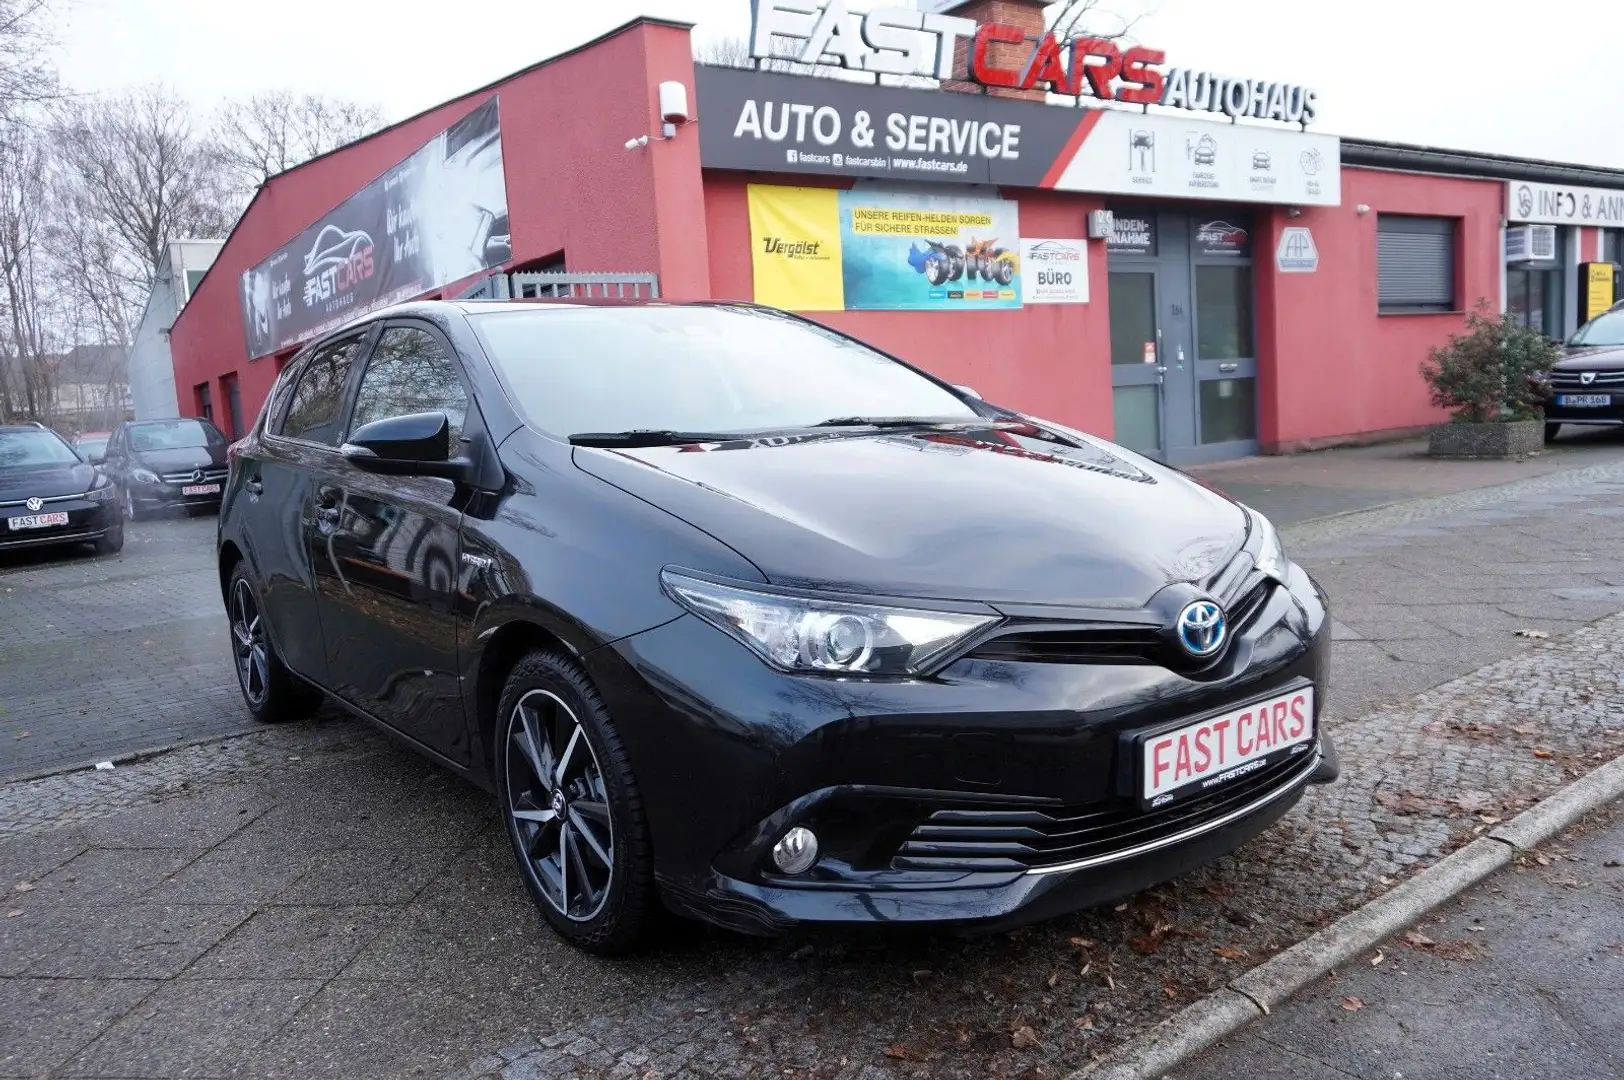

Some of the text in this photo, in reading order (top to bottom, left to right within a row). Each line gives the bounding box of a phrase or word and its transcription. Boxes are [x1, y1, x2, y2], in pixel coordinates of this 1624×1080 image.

[1160, 67, 1319, 125] AUTOHAUS
[733, 99, 1020, 159] AUTO & SERVICE
[799, 152, 830, 164] fastcars
[893, 157, 968, 173] www.fastcars.de
[1582, 194, 1592, 219] &
[854, 210, 991, 225] UNSERE REIFEN-HELDEN SORGEN
[1112, 218, 1149, 232] NDEN-
[855, 221, 873, 231] FÜR
[875, 223, 912, 234] SICHERE
[1107, 231, 1150, 245] NNAHME
[763, 236, 820, 258] Vergölst
[1038, 268, 1072, 286] BÜRO
[12, 513, 66, 527] FAST CARS
[1153, 695, 1306, 789] FAST CARS
